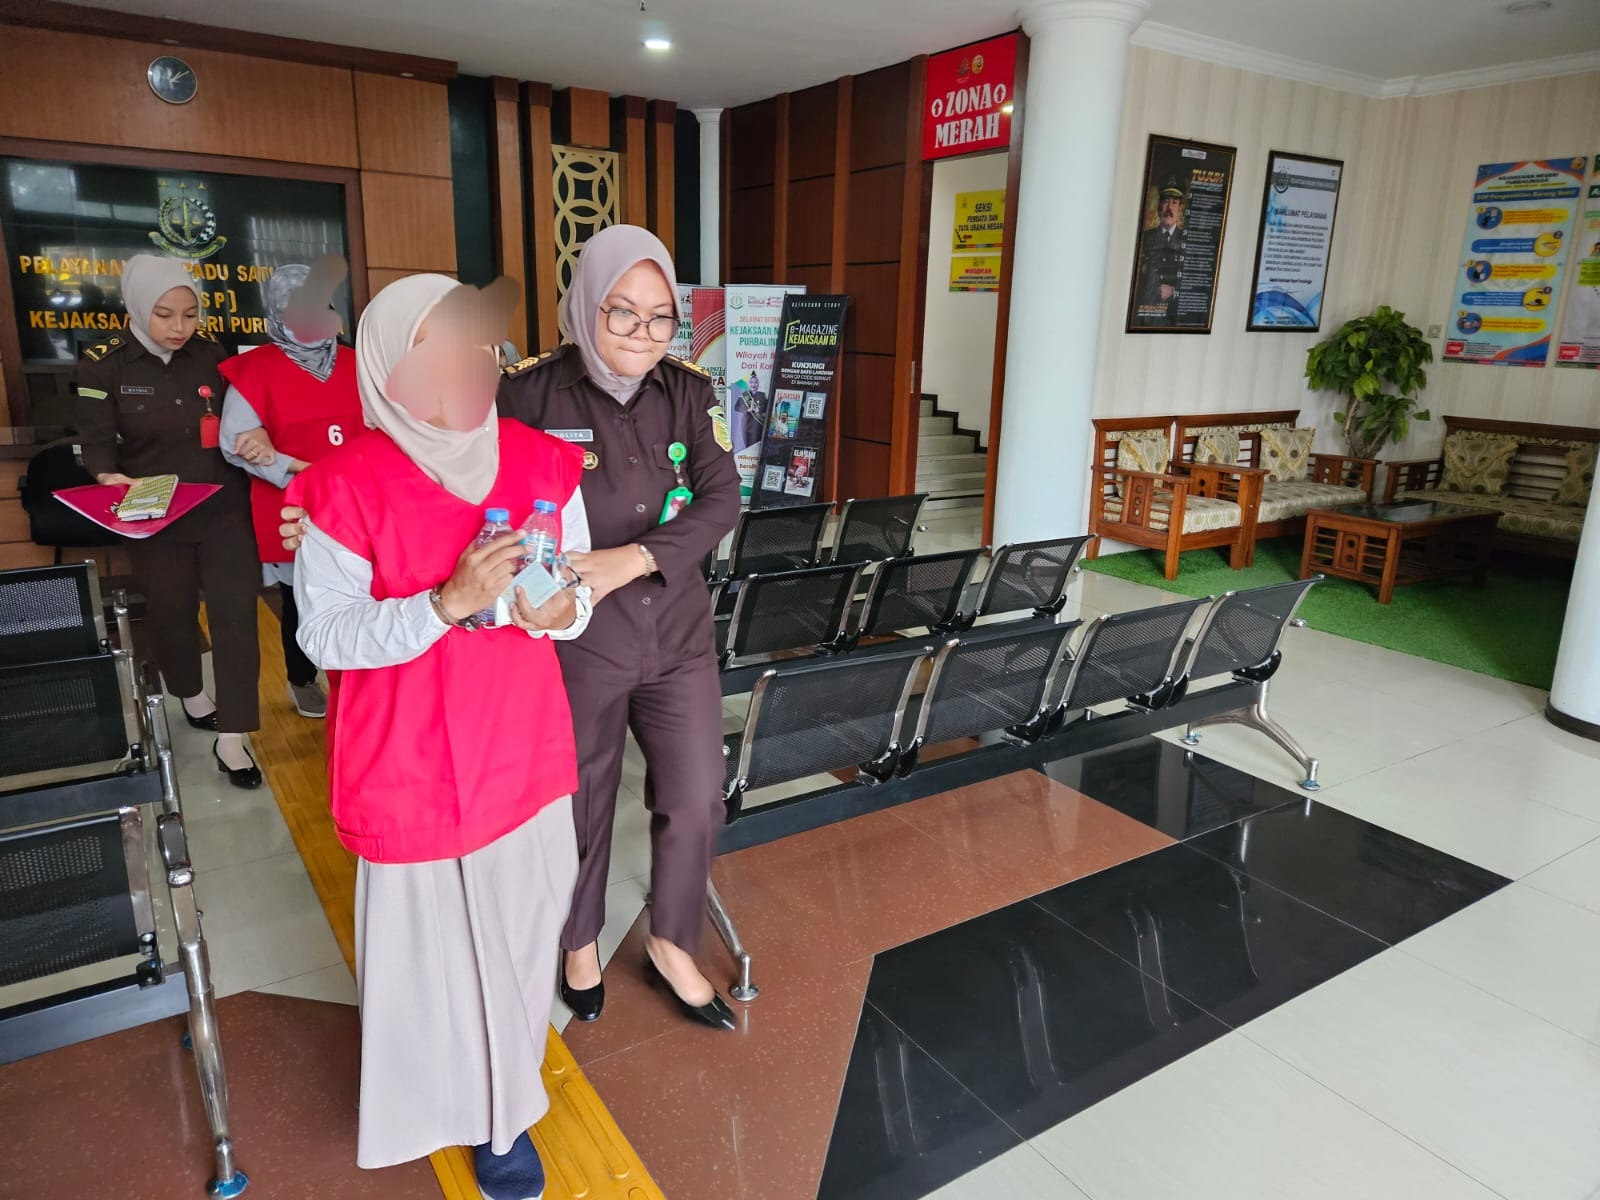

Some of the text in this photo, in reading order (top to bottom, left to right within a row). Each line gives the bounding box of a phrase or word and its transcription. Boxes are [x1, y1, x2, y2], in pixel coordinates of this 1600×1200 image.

[945, 84, 992, 117] ZONA
[934, 112, 1001, 149] MERAH
[730, 326, 772, 336] KEJAKSAAN
[789, 334, 827, 346] KEJAKSAAN
[328, 424, 344, 447] 6
[559, 431, 583, 439] OLITA
